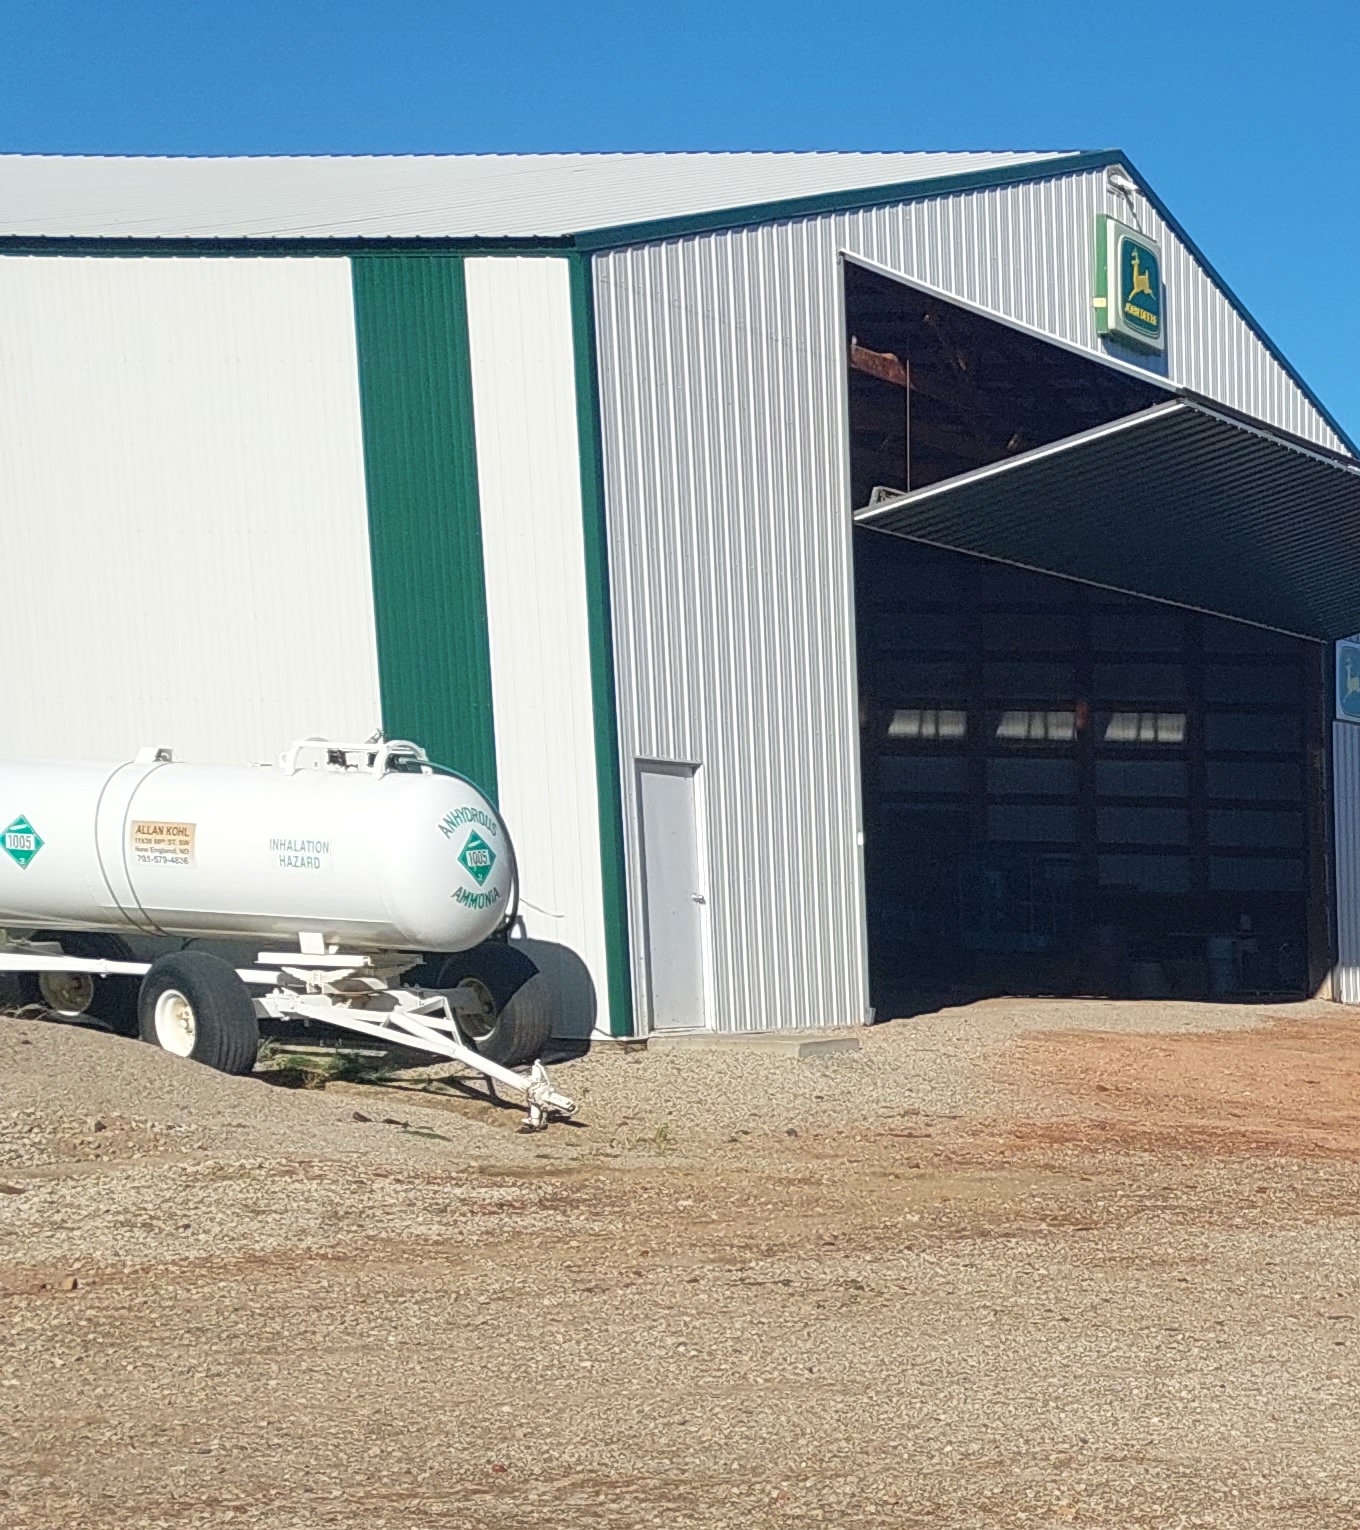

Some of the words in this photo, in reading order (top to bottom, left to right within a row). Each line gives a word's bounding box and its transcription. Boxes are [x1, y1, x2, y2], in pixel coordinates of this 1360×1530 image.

[135, 825, 164, 835] ALLAN
[166, 826, 190, 837] KOHL
[438, 807, 497, 839] ANHYDROUS
[8, 834, 32, 850] 1005
[269, 838, 330, 854] INHALATION
[279, 854, 321, 870] HAZARD
[468, 851, 488, 865] 1005
[451, 886, 500, 910] AMMONIA
